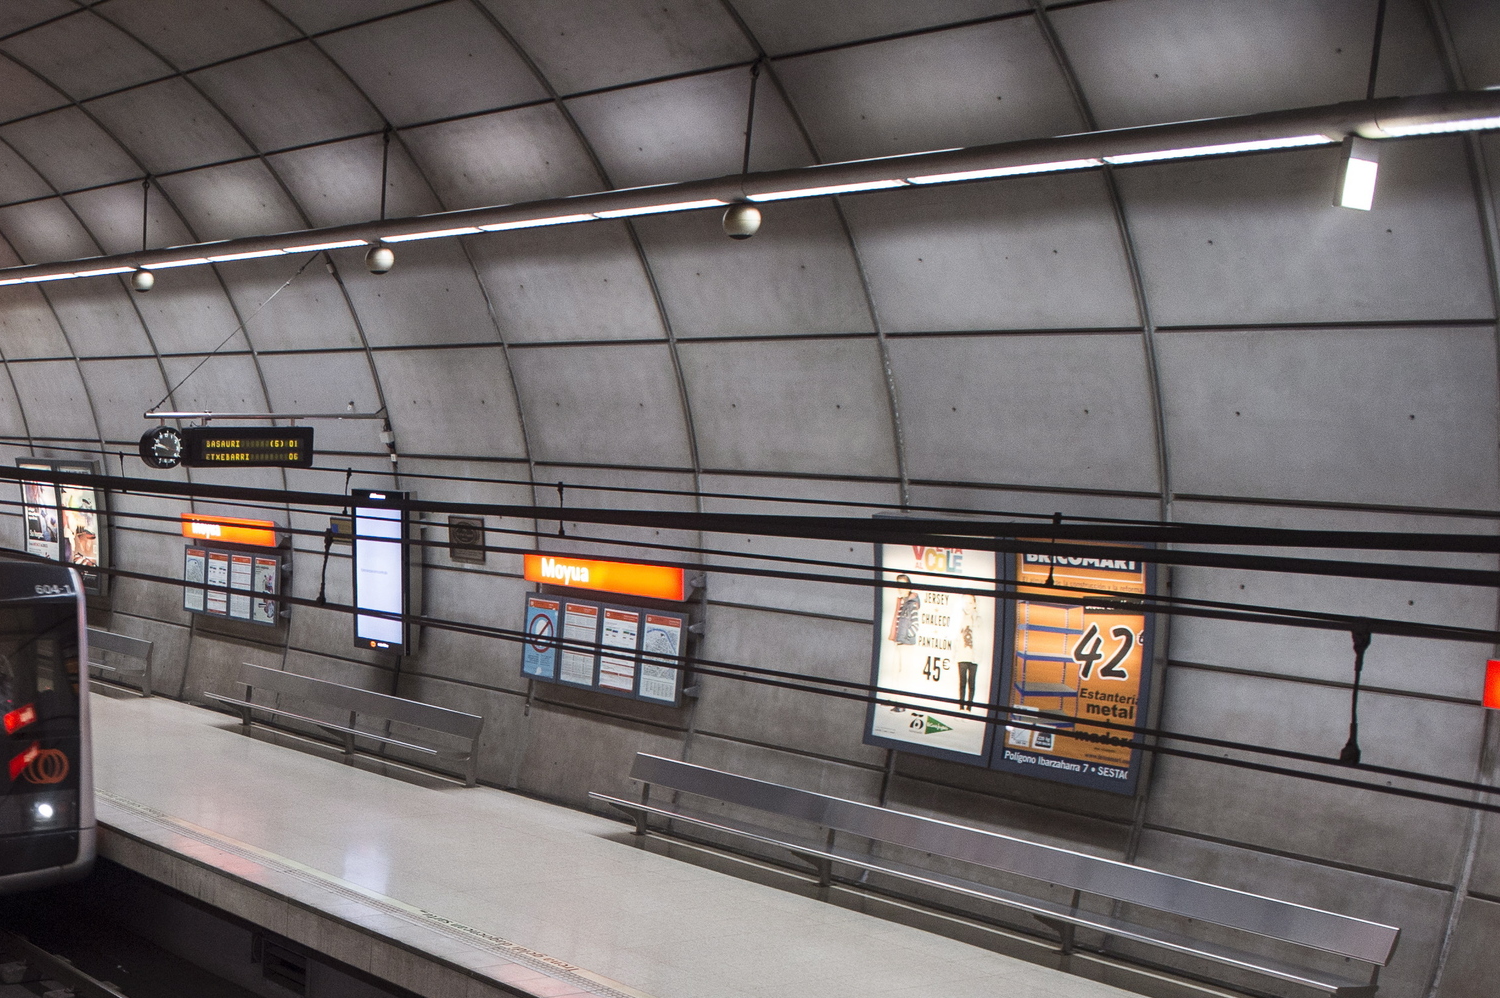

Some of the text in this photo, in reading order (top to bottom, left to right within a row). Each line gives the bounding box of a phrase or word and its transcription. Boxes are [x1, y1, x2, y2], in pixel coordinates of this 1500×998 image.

[205, 453, 250, 461] ETXEBARRI
[925, 548, 963, 574] COLE
[541, 557, 590, 585] Moyua
[35, 584, 72, 595] 604-1
[924, 592, 950, 606] JERSEY
[921, 613, 951, 627] CHALECO
[1086, 703, 1135, 720] metal
[1004, 750, 1037, 764] Polígono
[1038, 755, 1081, 773] Ibarzaharra
[1082, 763, 1089, 773] 7
